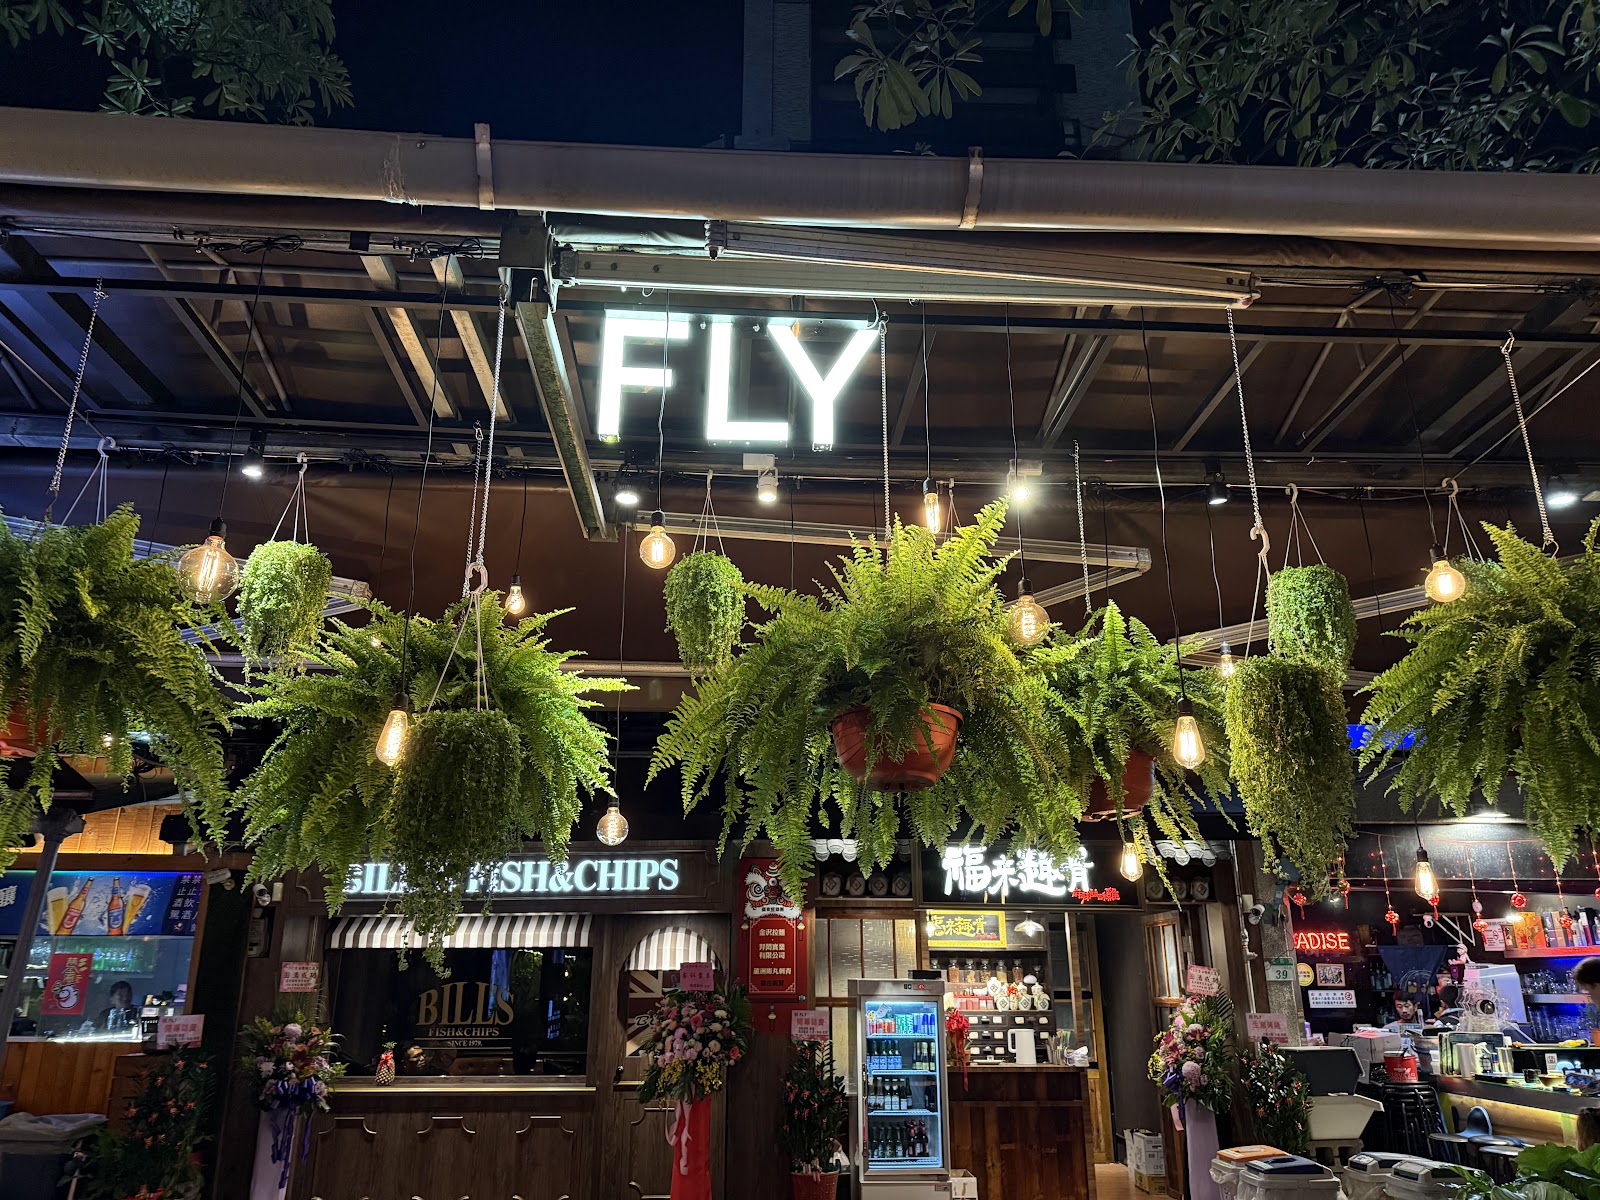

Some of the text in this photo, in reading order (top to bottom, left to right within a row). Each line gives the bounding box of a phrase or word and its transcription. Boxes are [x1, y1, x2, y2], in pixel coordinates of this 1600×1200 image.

[597, 315, 880, 443] FLY
[466, 858, 679, 893] FISH&CHIPS
[1293, 931, 1350, 950] ADISE
[759, 951, 786, 960] 有限公司
[1274, 969, 1289, 980] 39
[416, 981, 514, 1025] BILL'S
[428, 1027, 500, 1037] FISH&CHIPS
[447, 1039, 468, 1047] SINCE
